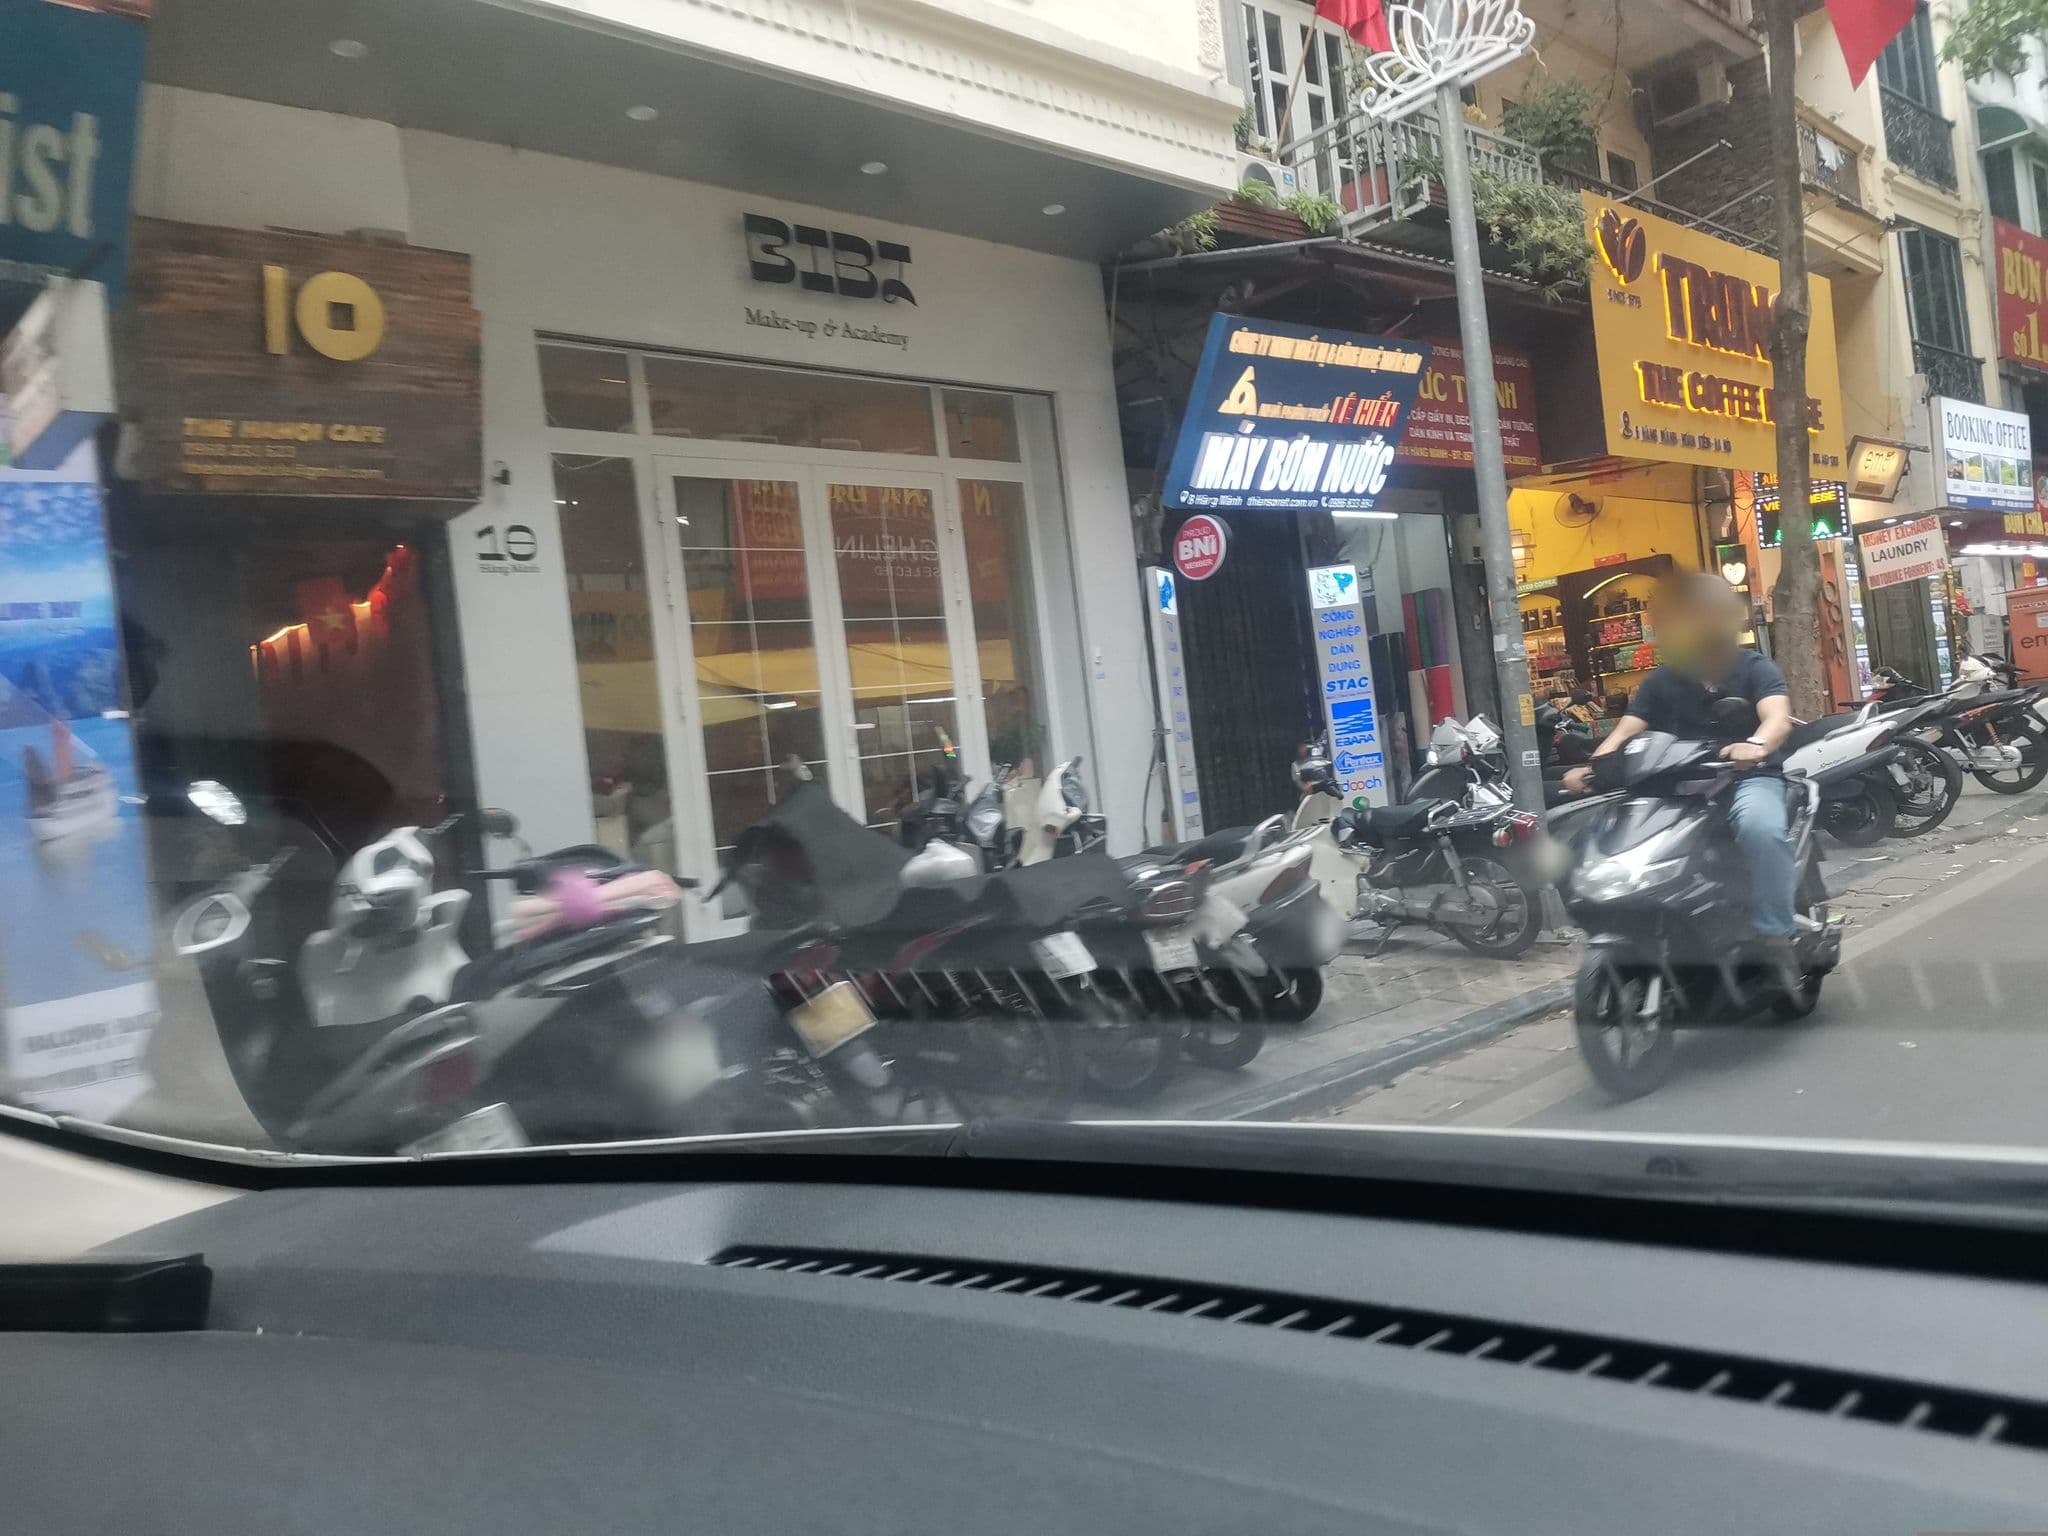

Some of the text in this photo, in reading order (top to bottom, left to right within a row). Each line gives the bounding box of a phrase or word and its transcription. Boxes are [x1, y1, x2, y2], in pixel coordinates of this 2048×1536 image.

[2002, 240, 2042, 305] BÚN
[1652, 250, 1775, 364] TRUN
[744, 306, 910, 351] Make-up & Academy
[1633, 359, 1684, 409] THE
[1683, 370, 1764, 423] COFFEE
[1947, 411, 2027, 450] BOOKING OFFICE
[1192, 420, 1395, 495] MÁY BƠM NƯỚC
[475, 524, 538, 562] 10
[1178, 534, 1218, 561] BNI
[1862, 516, 1939, 548] MONEY EXCHANGE
[1183, 558, 1215, 570] MEMBER
[1871, 537, 1929, 563] LAUNDRY
[1534, 577, 1558, 590] COFFEE
[1326, 676, 1369, 692] STAC
[1335, 734, 1376, 747] EBARA
[1342, 776, 1383, 793] dooch
